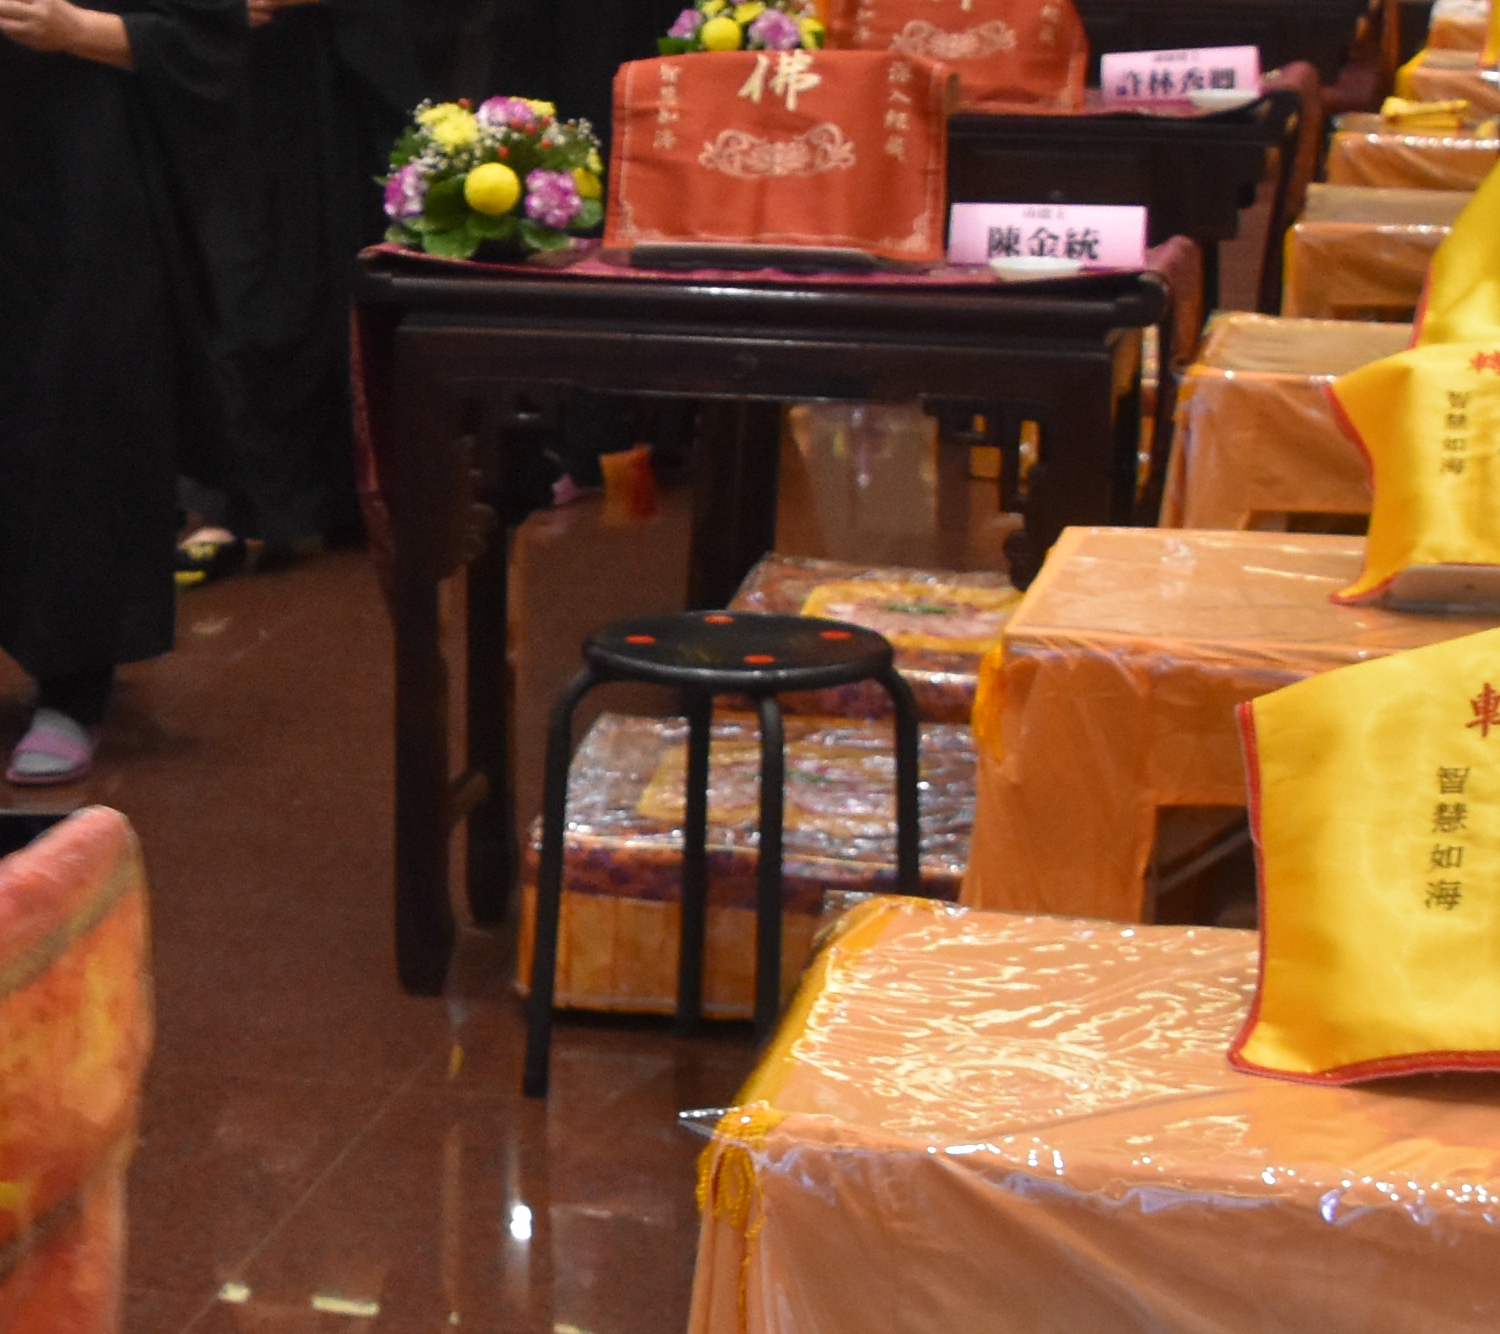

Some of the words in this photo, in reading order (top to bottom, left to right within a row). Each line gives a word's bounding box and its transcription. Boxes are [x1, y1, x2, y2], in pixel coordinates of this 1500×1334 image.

[737, 48, 823, 112] 佛
[987, 225, 1100, 260] 陳金統
[1424, 765, 1471, 912] 智慧如海
